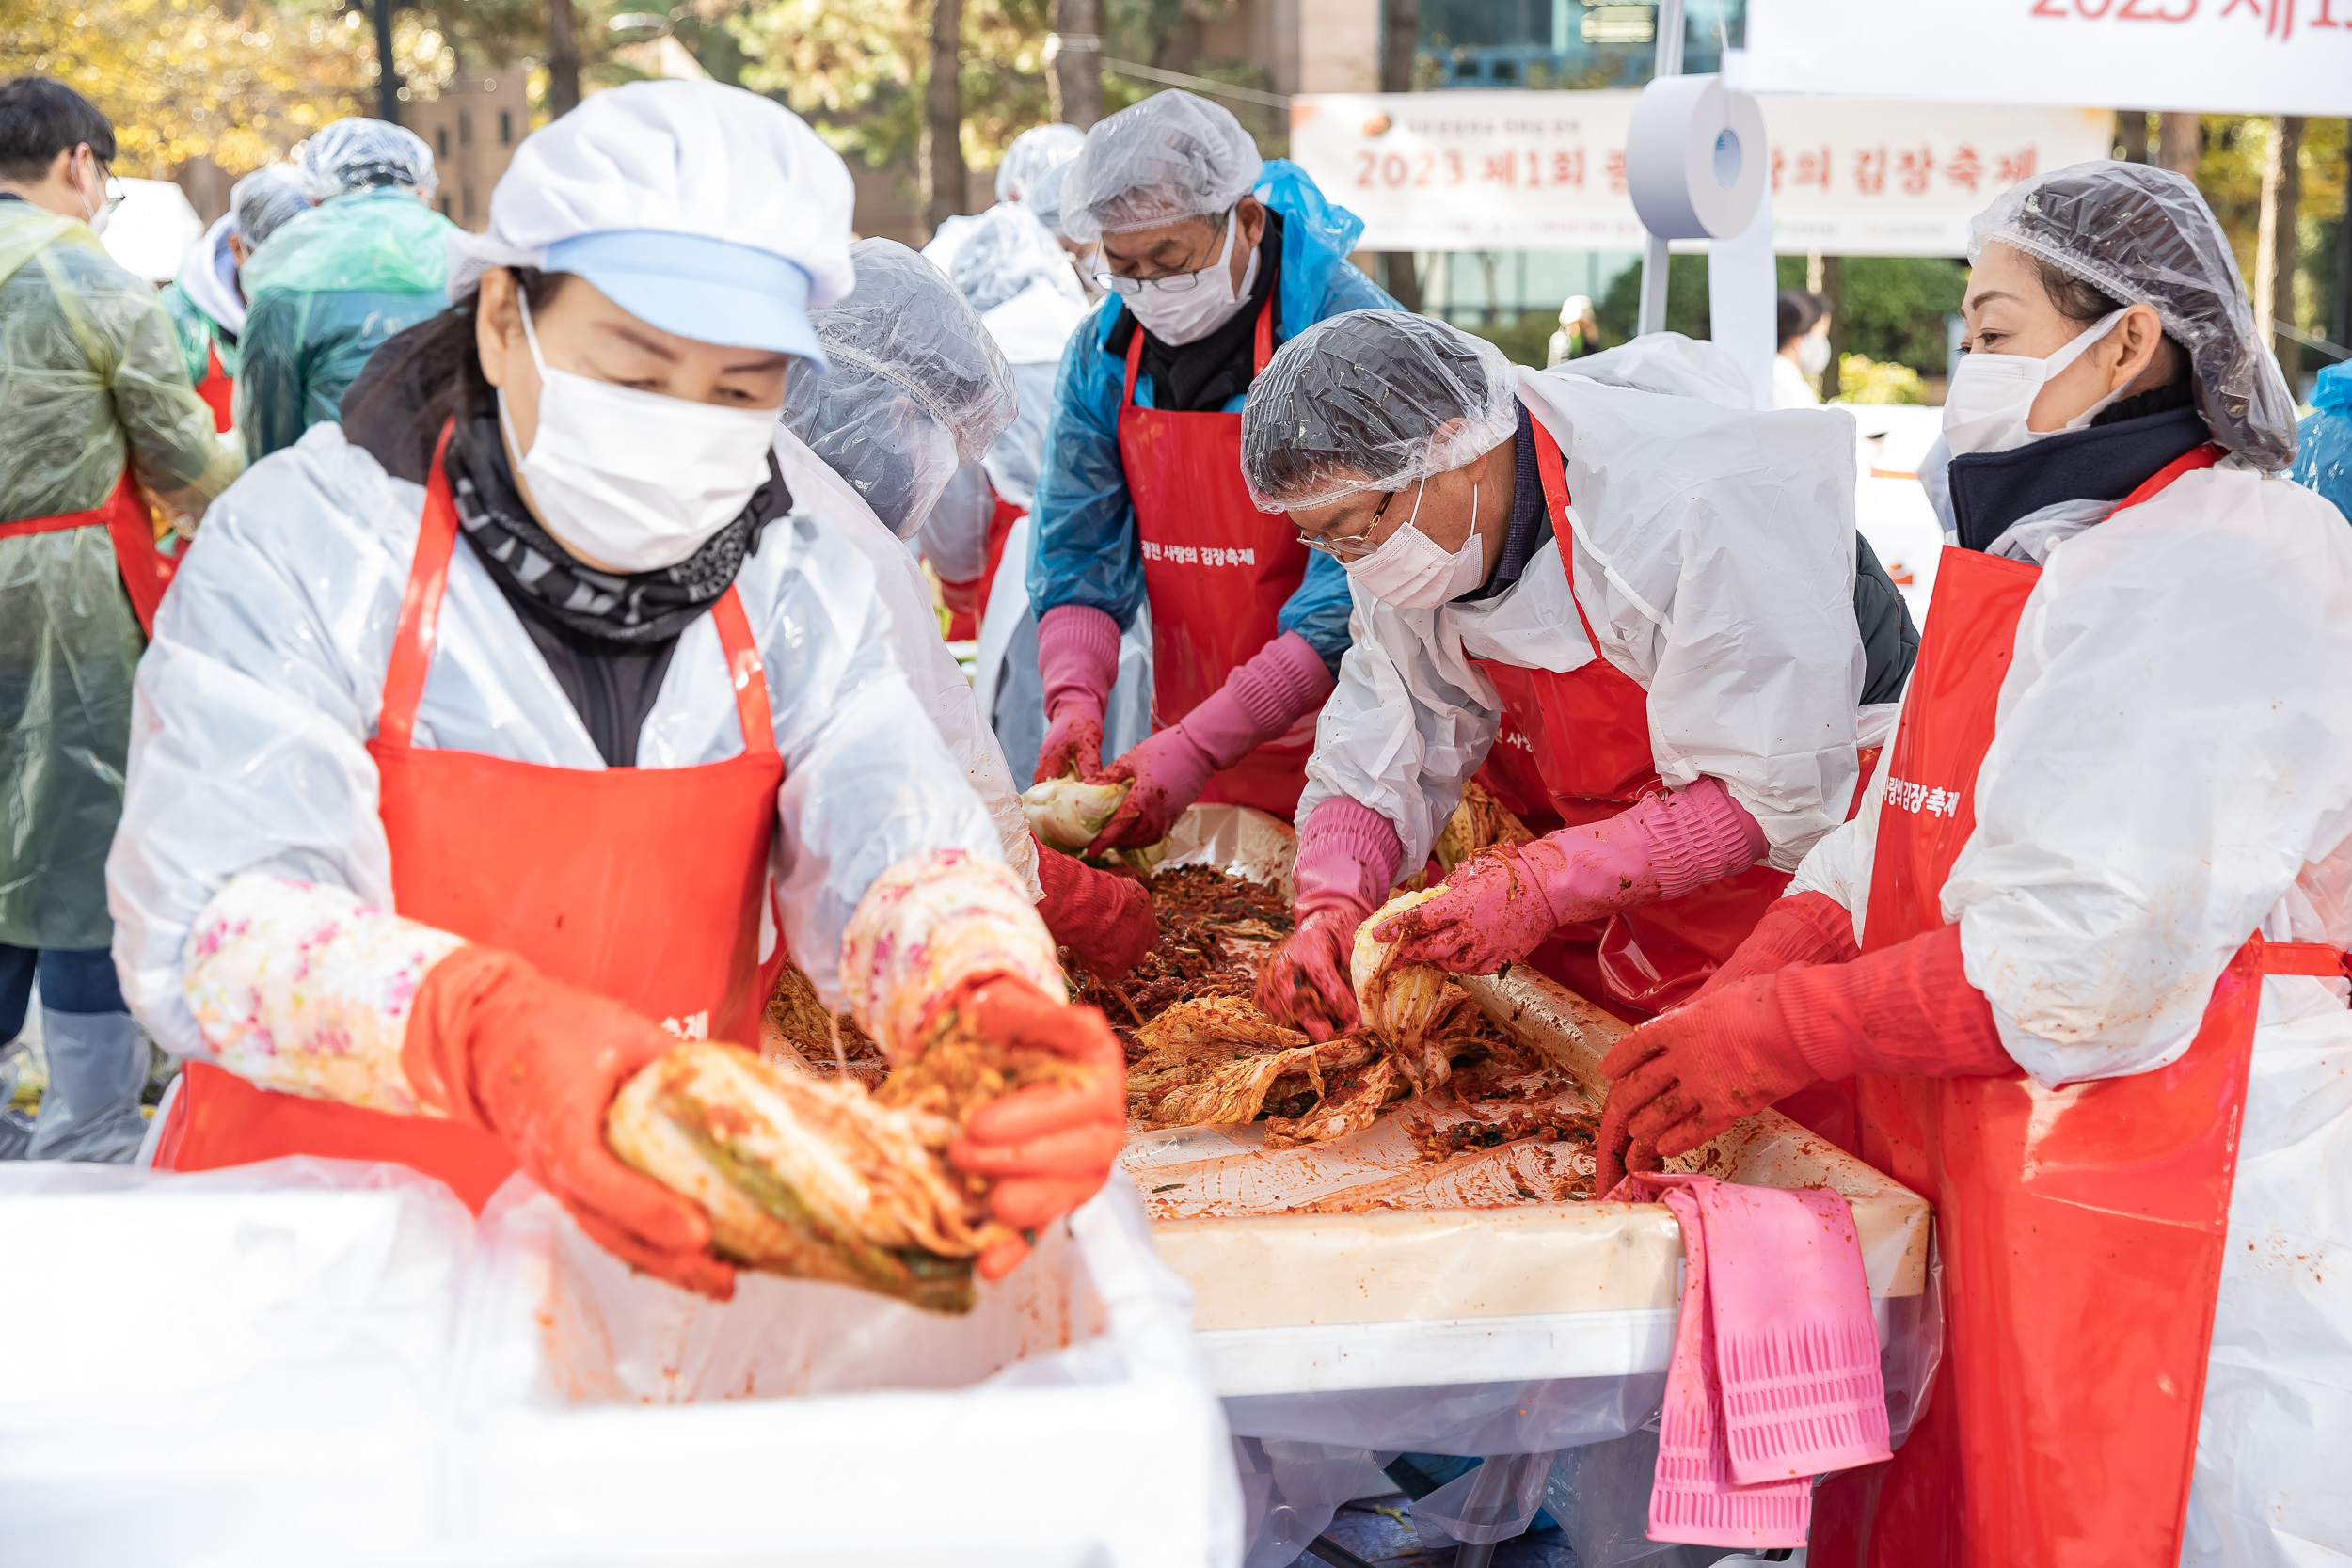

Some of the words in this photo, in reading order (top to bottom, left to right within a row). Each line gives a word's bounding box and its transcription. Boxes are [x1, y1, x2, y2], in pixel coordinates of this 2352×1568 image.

[1355, 149, 1466, 188] 2023
[1481, 147, 1586, 191] 제1회
[1851, 143, 2040, 196] 김장축제
[1200, 546, 1256, 567] 김장축제
[1903, 781, 1960, 818] 김장축제
